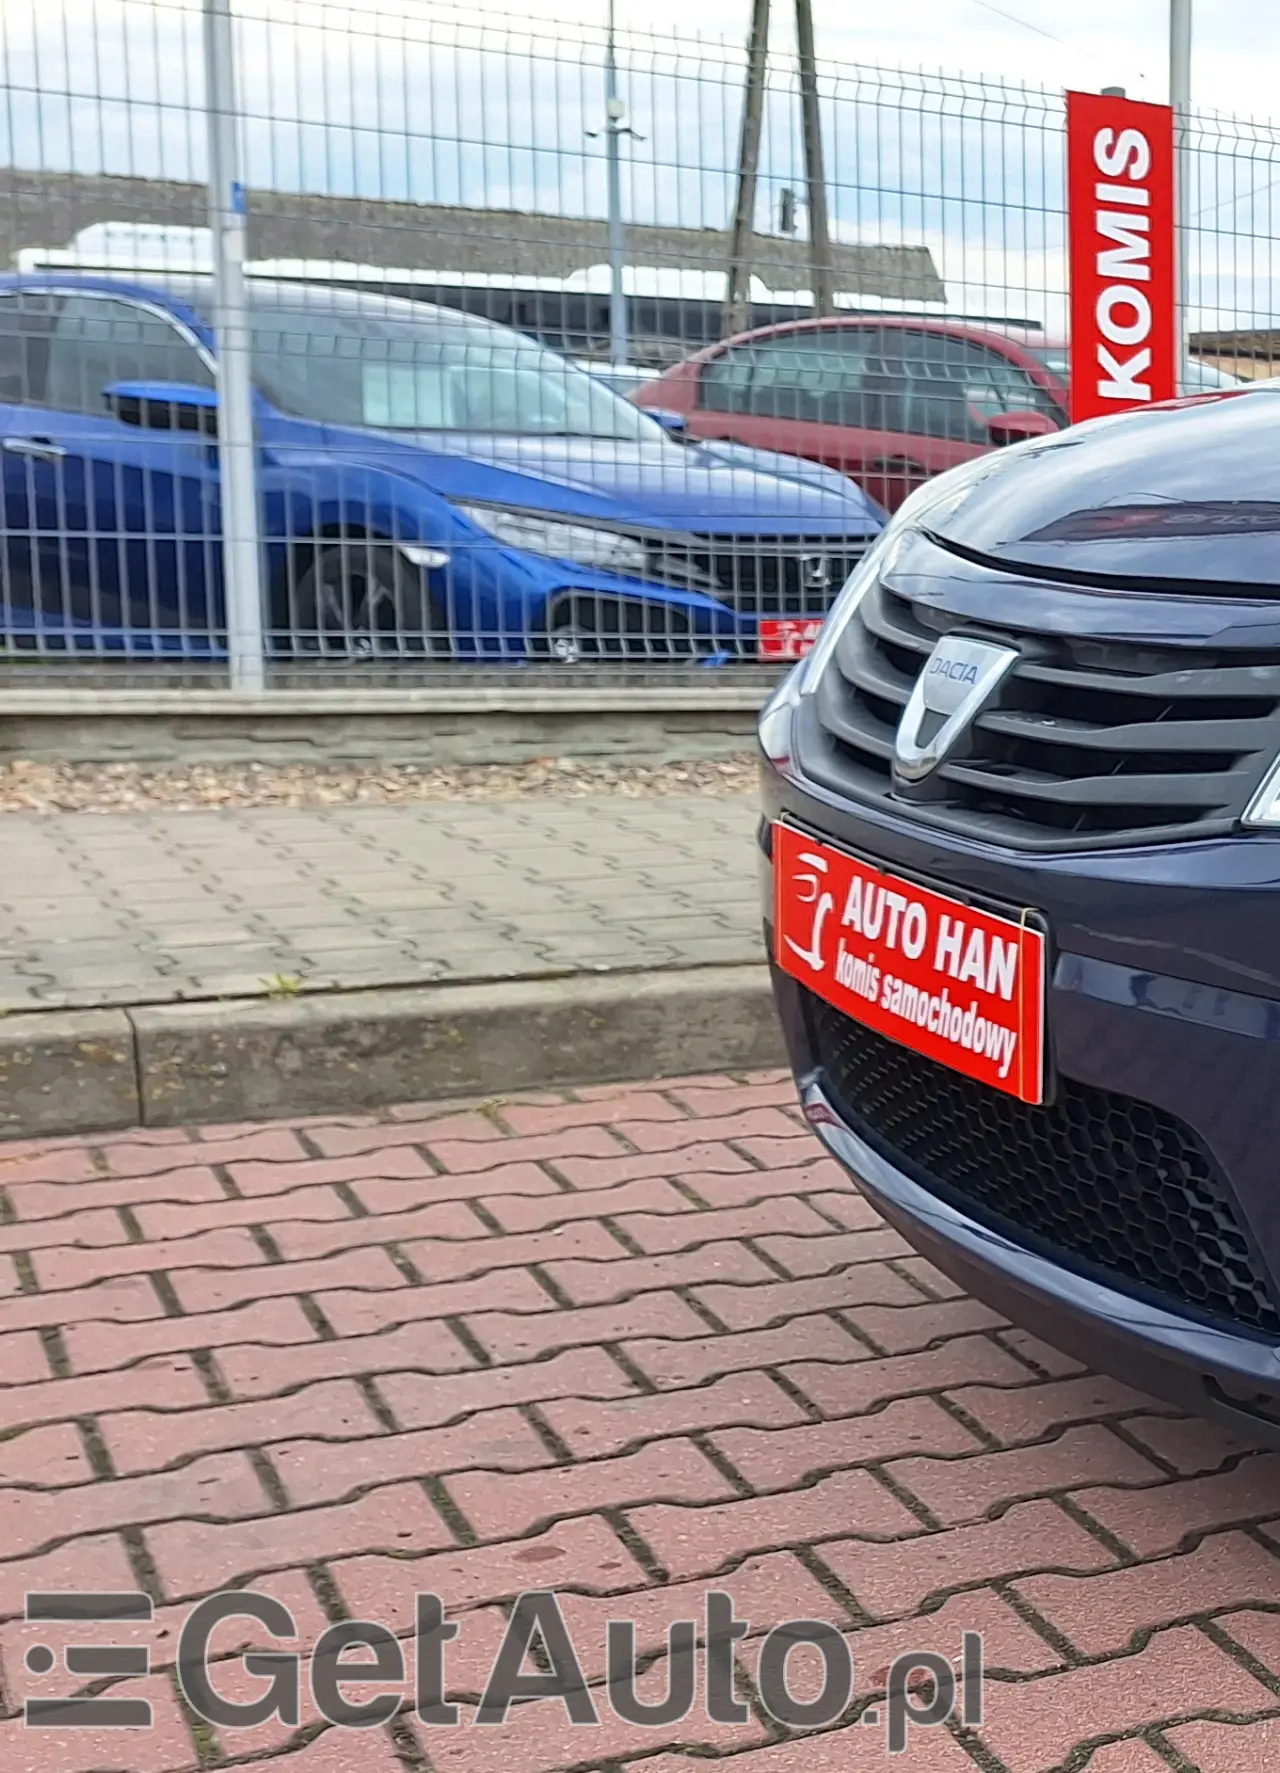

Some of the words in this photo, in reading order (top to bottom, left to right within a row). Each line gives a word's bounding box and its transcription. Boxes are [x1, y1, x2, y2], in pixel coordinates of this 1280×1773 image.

[1094, 127, 1151, 402] KOMIS
[929, 658, 978, 685] DACIA
[842, 876, 927, 960] AUTO
[933, 914, 1019, 1001] HAN
[835, 937, 881, 1002] komis
[880, 974, 1017, 1079] samochodowy
